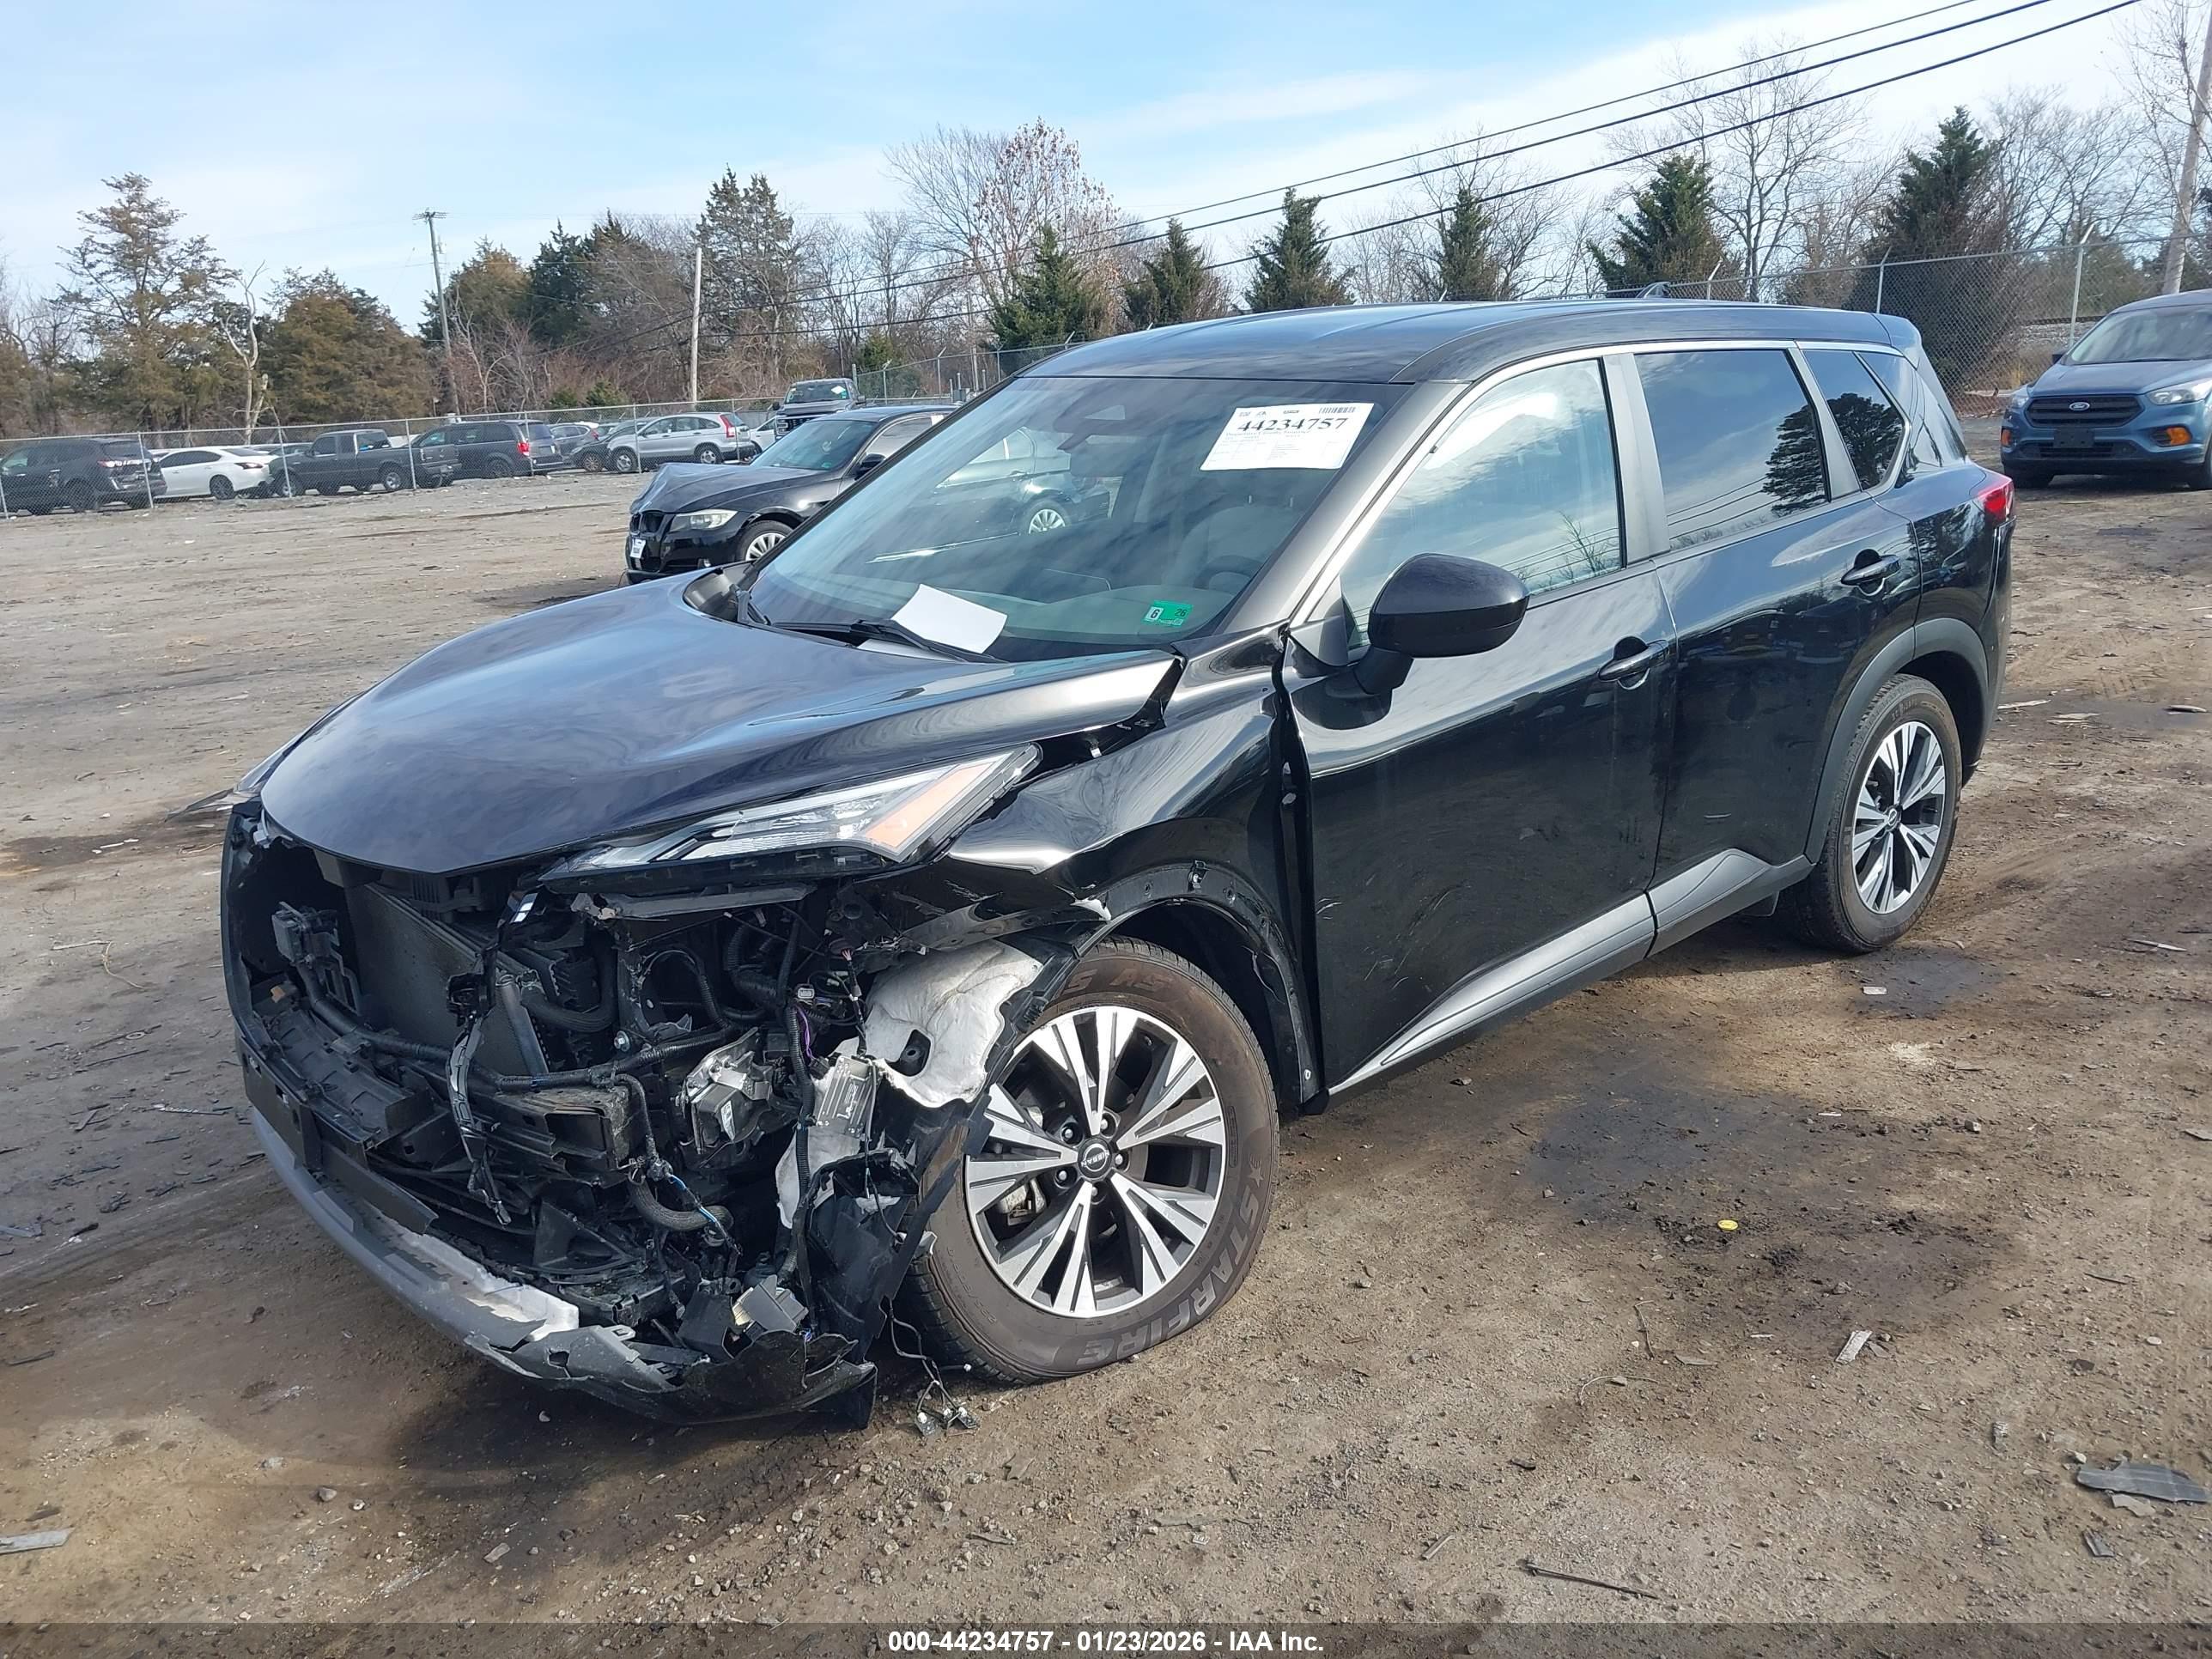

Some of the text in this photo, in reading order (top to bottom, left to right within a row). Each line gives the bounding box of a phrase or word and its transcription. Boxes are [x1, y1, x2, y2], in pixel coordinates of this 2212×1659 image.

[1237, 418, 1349, 432] 44234757
[1150, 609, 1188, 619] 6 26
[1080, 1149, 1110, 1168] NISSAN
[1075, 1185, 1260, 1366] STARFIRE
